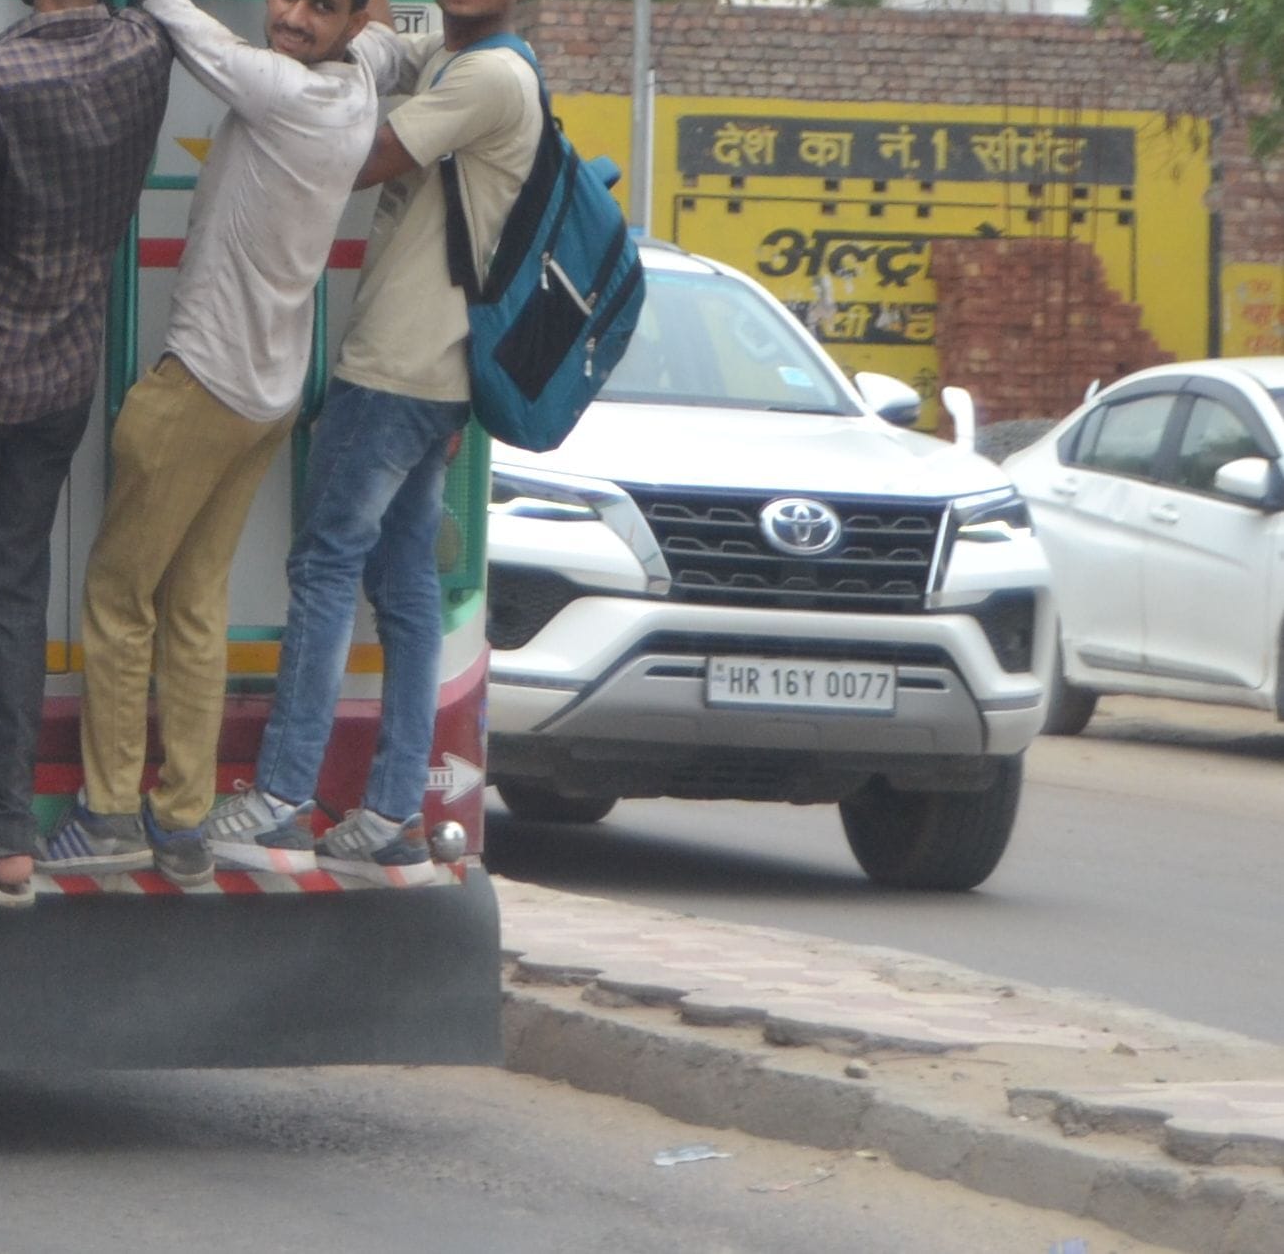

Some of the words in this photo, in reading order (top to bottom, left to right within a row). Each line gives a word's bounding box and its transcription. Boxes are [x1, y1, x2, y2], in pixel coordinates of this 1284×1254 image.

[714, 122, 779, 167] देश
[798, 130, 854, 168] का
[970, 125, 1087, 174] सीमेंट
[730, 666, 760, 694] HR
[772, 668, 815, 696] 16Y
[826, 671, 890, 699] 0077
